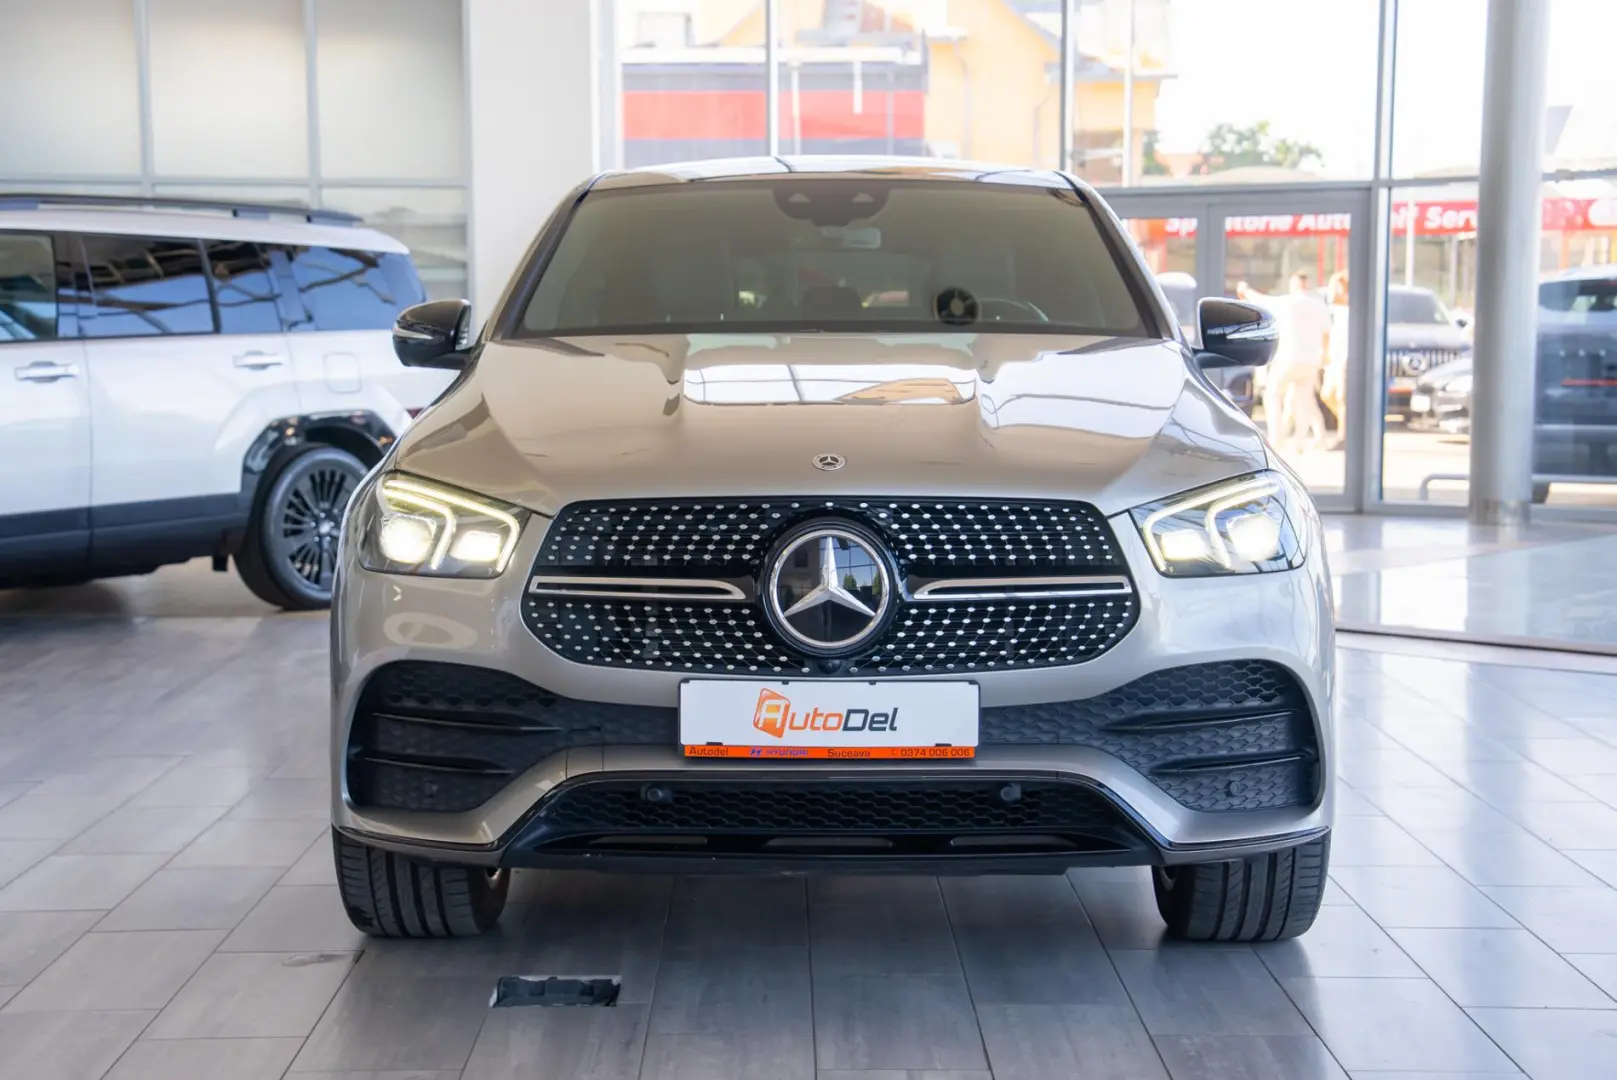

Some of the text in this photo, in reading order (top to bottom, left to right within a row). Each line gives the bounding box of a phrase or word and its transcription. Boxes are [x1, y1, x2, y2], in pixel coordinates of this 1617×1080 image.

[1298, 213, 1352, 231] Aut
[755, 694, 899, 733] AutoDel
[688, 746, 729, 756] Autodel
[827, 748, 871, 758] Suceava
[901, 748, 926, 757] 0374
[929, 748, 948, 757] 006
[951, 748, 970, 757] 006
